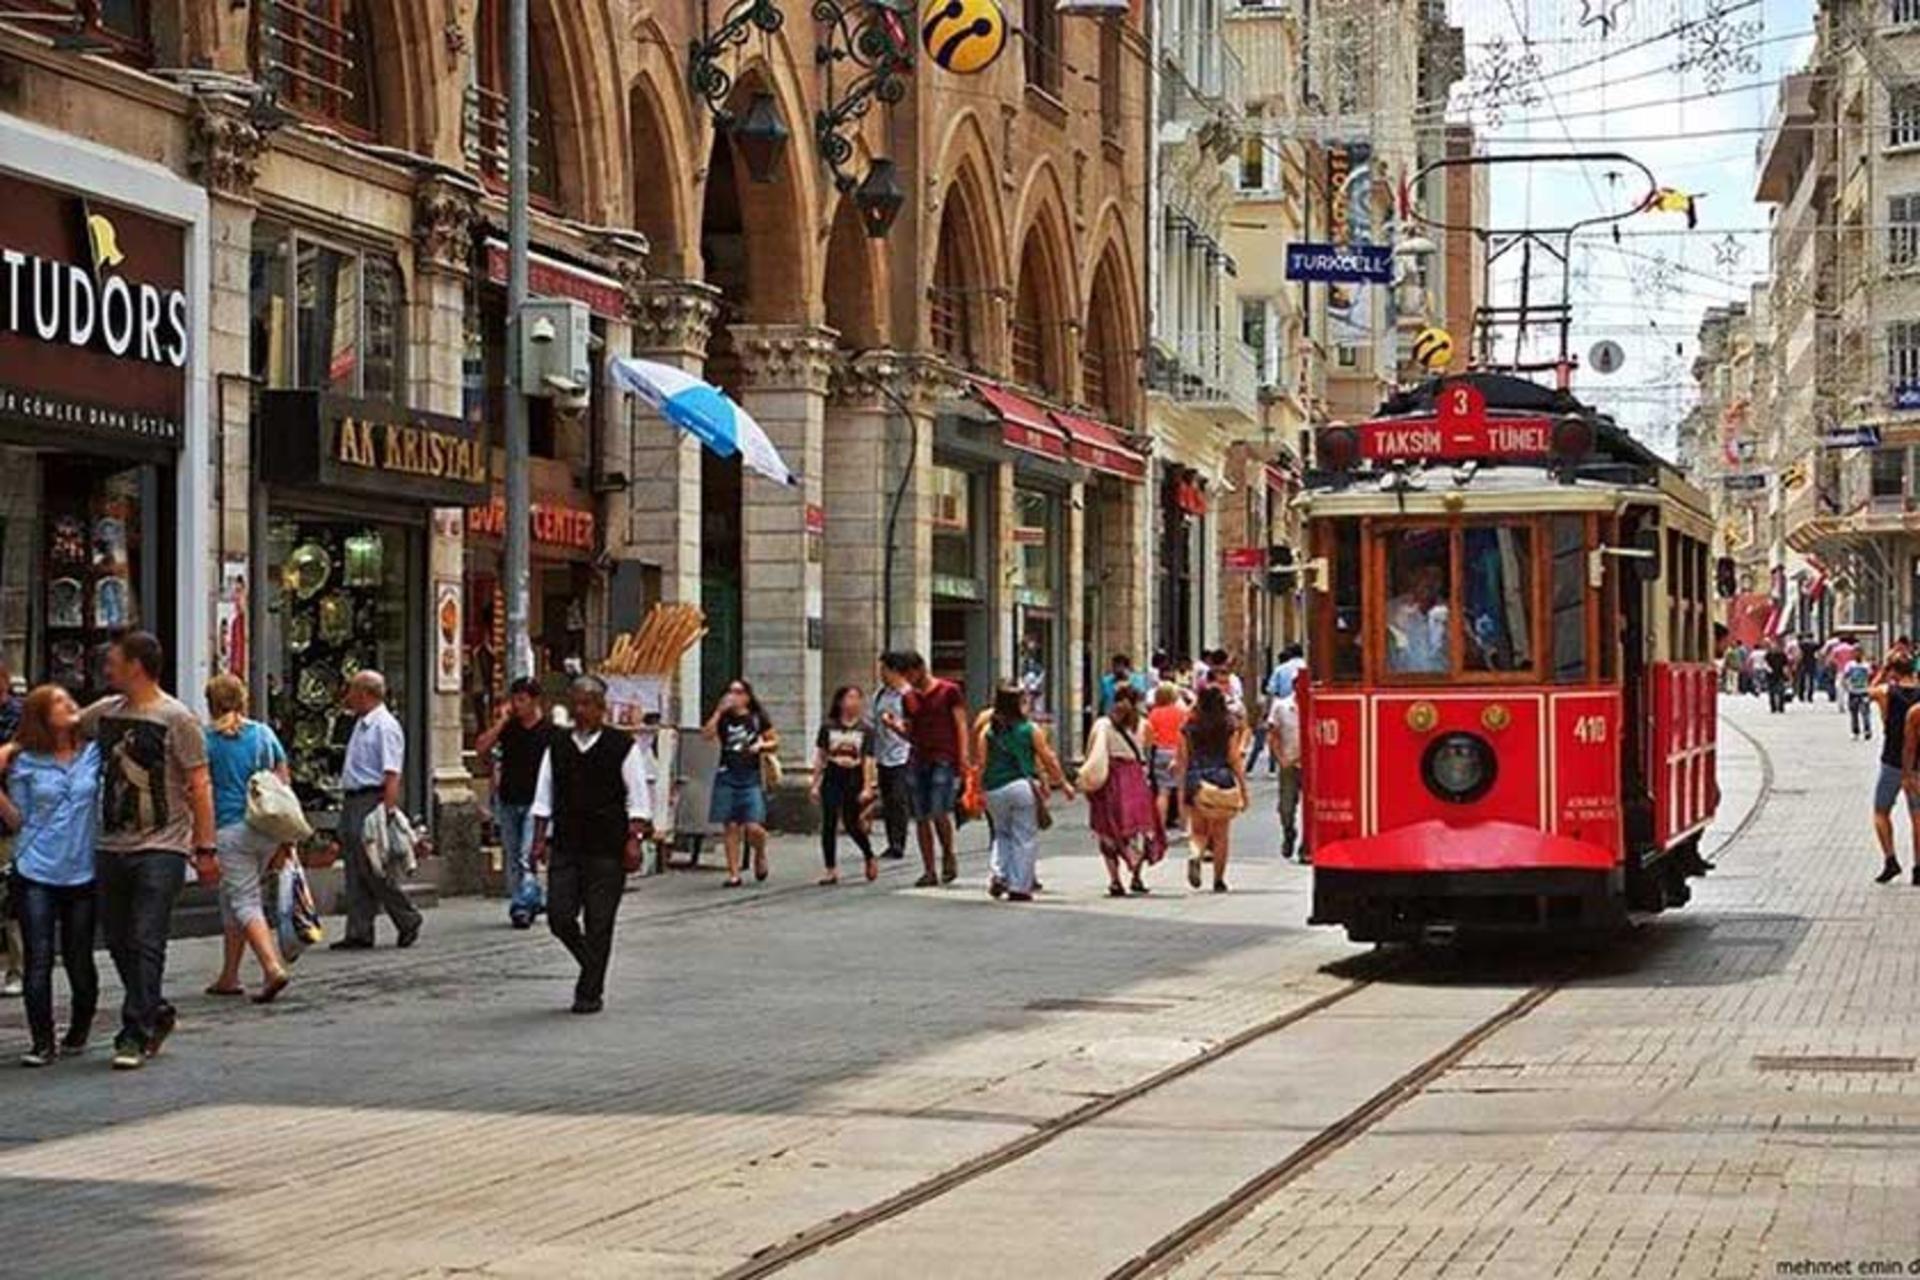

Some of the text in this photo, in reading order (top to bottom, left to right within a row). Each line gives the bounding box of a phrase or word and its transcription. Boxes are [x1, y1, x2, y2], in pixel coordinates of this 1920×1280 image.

[1290, 253, 1387, 273] TURKCELL
[3, 248, 187, 367] TUDORS
[1453, 389, 1469, 415] 3
[340, 417, 375, 466] AK
[1574, 715, 1606, 743] 410
